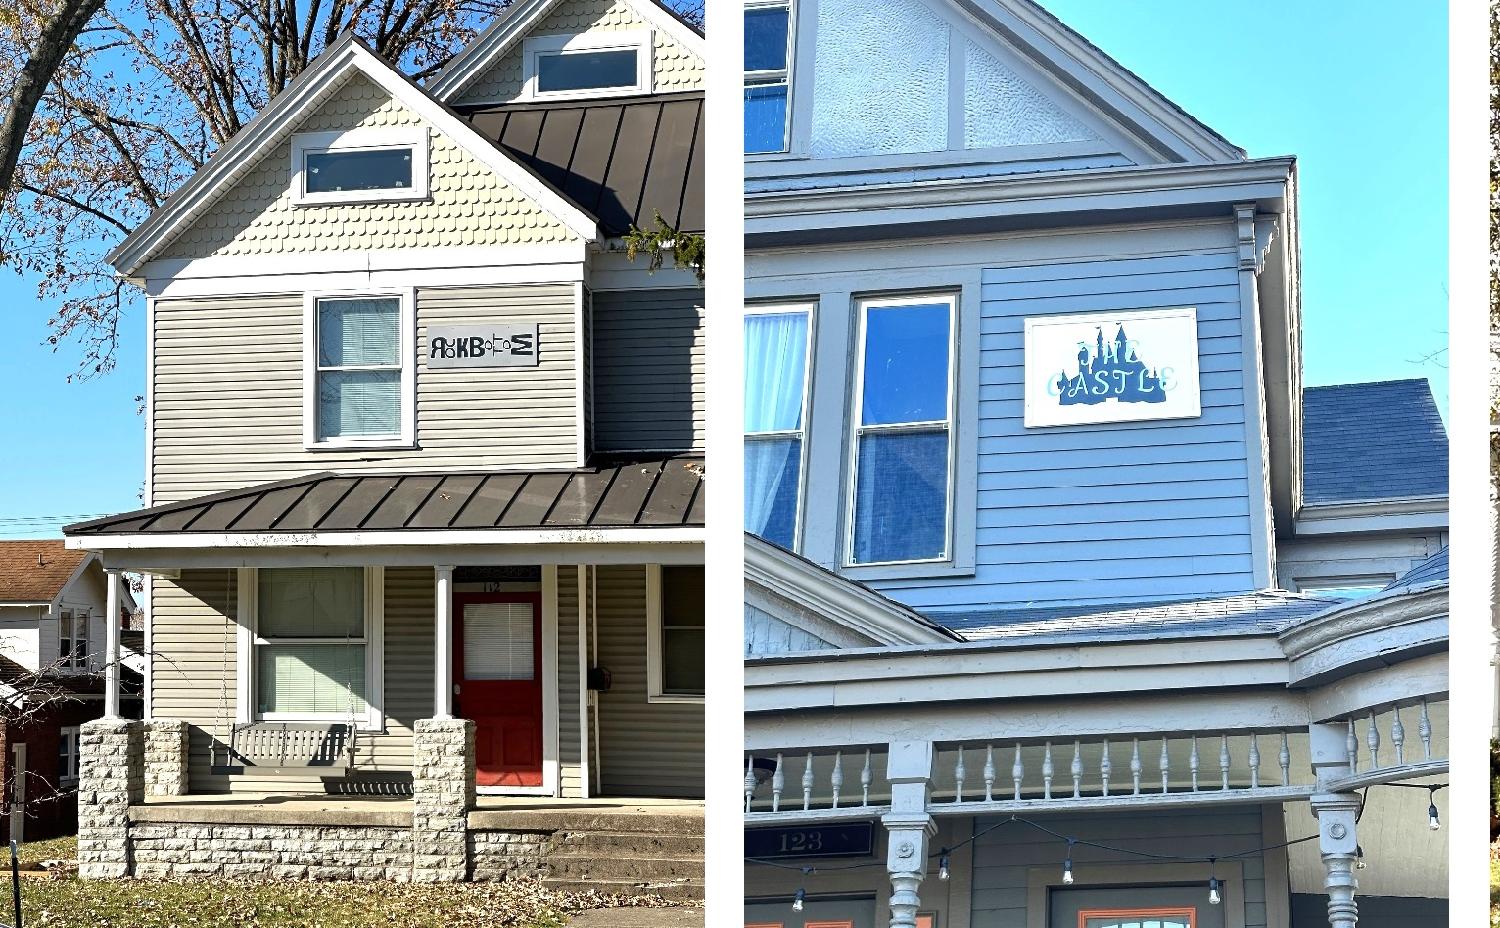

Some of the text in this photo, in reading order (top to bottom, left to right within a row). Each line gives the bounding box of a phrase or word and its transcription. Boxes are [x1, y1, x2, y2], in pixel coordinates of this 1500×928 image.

[1078, 339, 1143, 366] THE
[1047, 366, 1178, 397] CASTLE
[779, 831, 823, 852] 123
